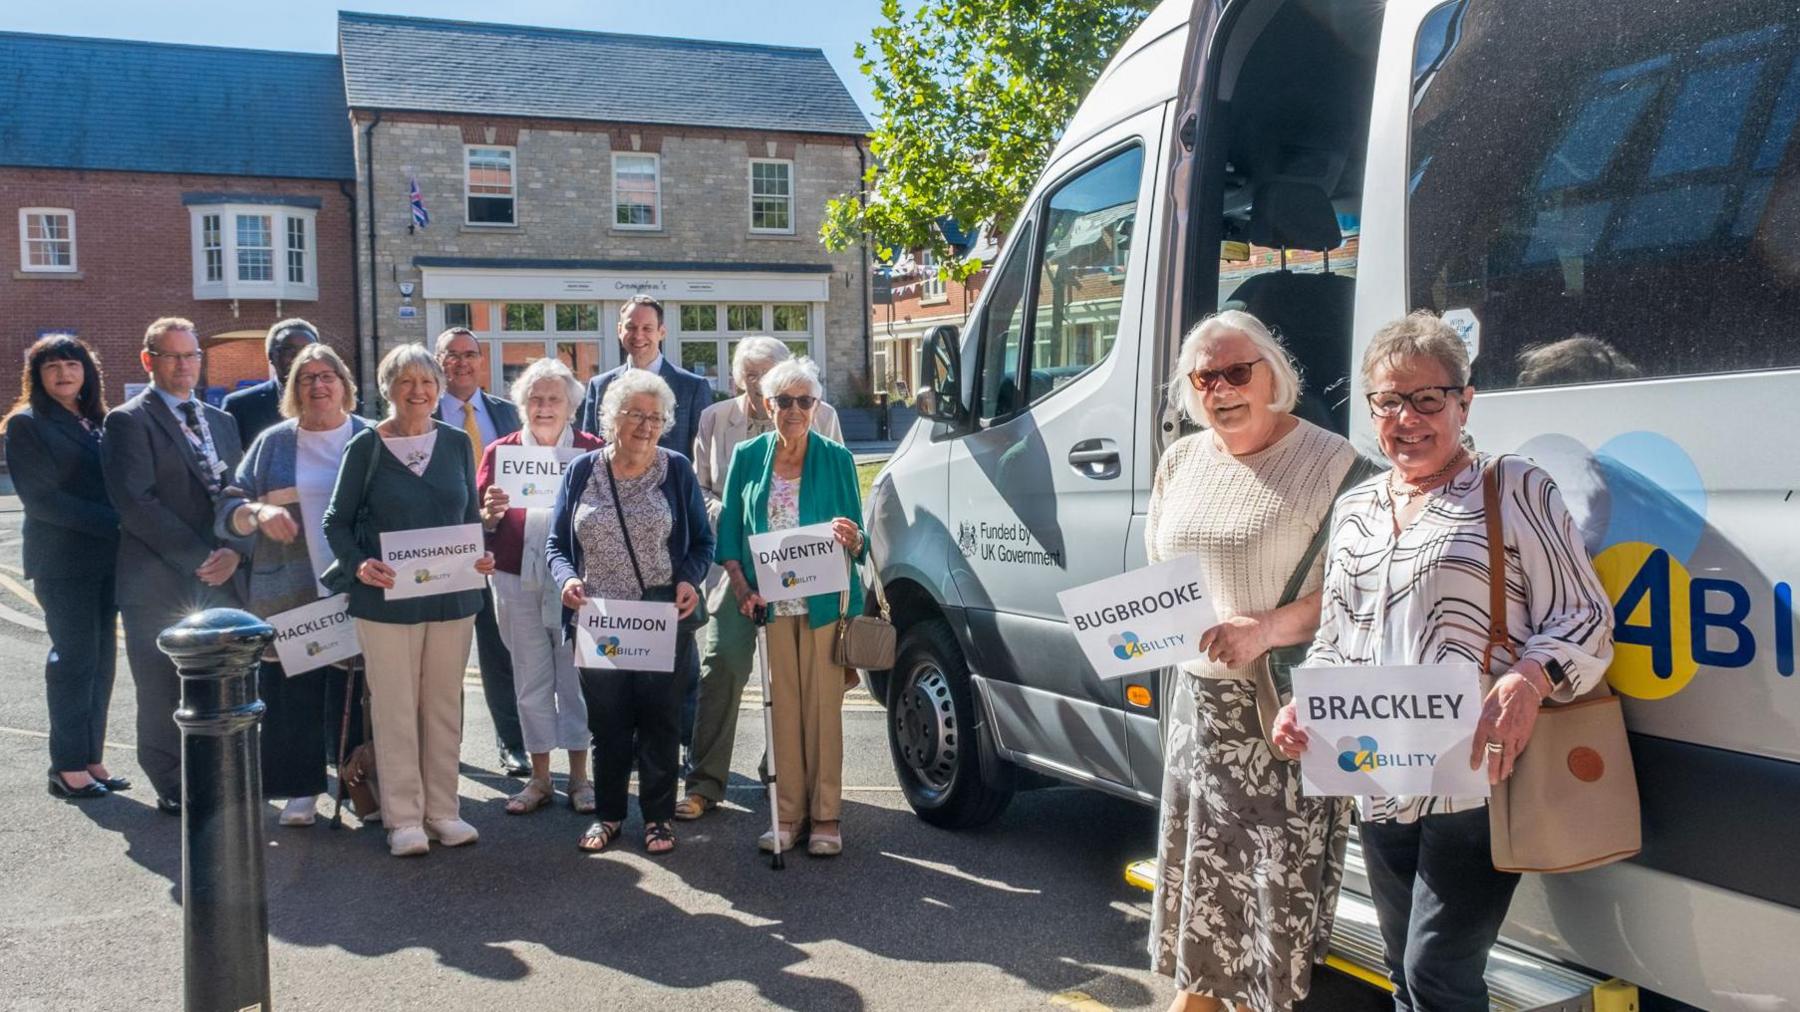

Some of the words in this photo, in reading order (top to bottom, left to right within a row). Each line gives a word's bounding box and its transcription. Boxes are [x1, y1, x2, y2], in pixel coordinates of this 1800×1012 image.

[502, 460, 568, 476] EVENLE
[980, 522, 1017, 541] Funded
[1019, 524, 1032, 546] by
[388, 543, 478, 561] DEANSHANGER
[759, 540, 836, 565] DAVENTRY
[981, 543, 996, 561] UK
[997, 544, 1061, 567] Government
[1073, 582, 1203, 631] BUGBROOKE
[588, 615, 667, 632] HELMDON
[1308, 694, 1465, 720] BRACKLEY
[1358, 751, 1438, 769] ABILITY
